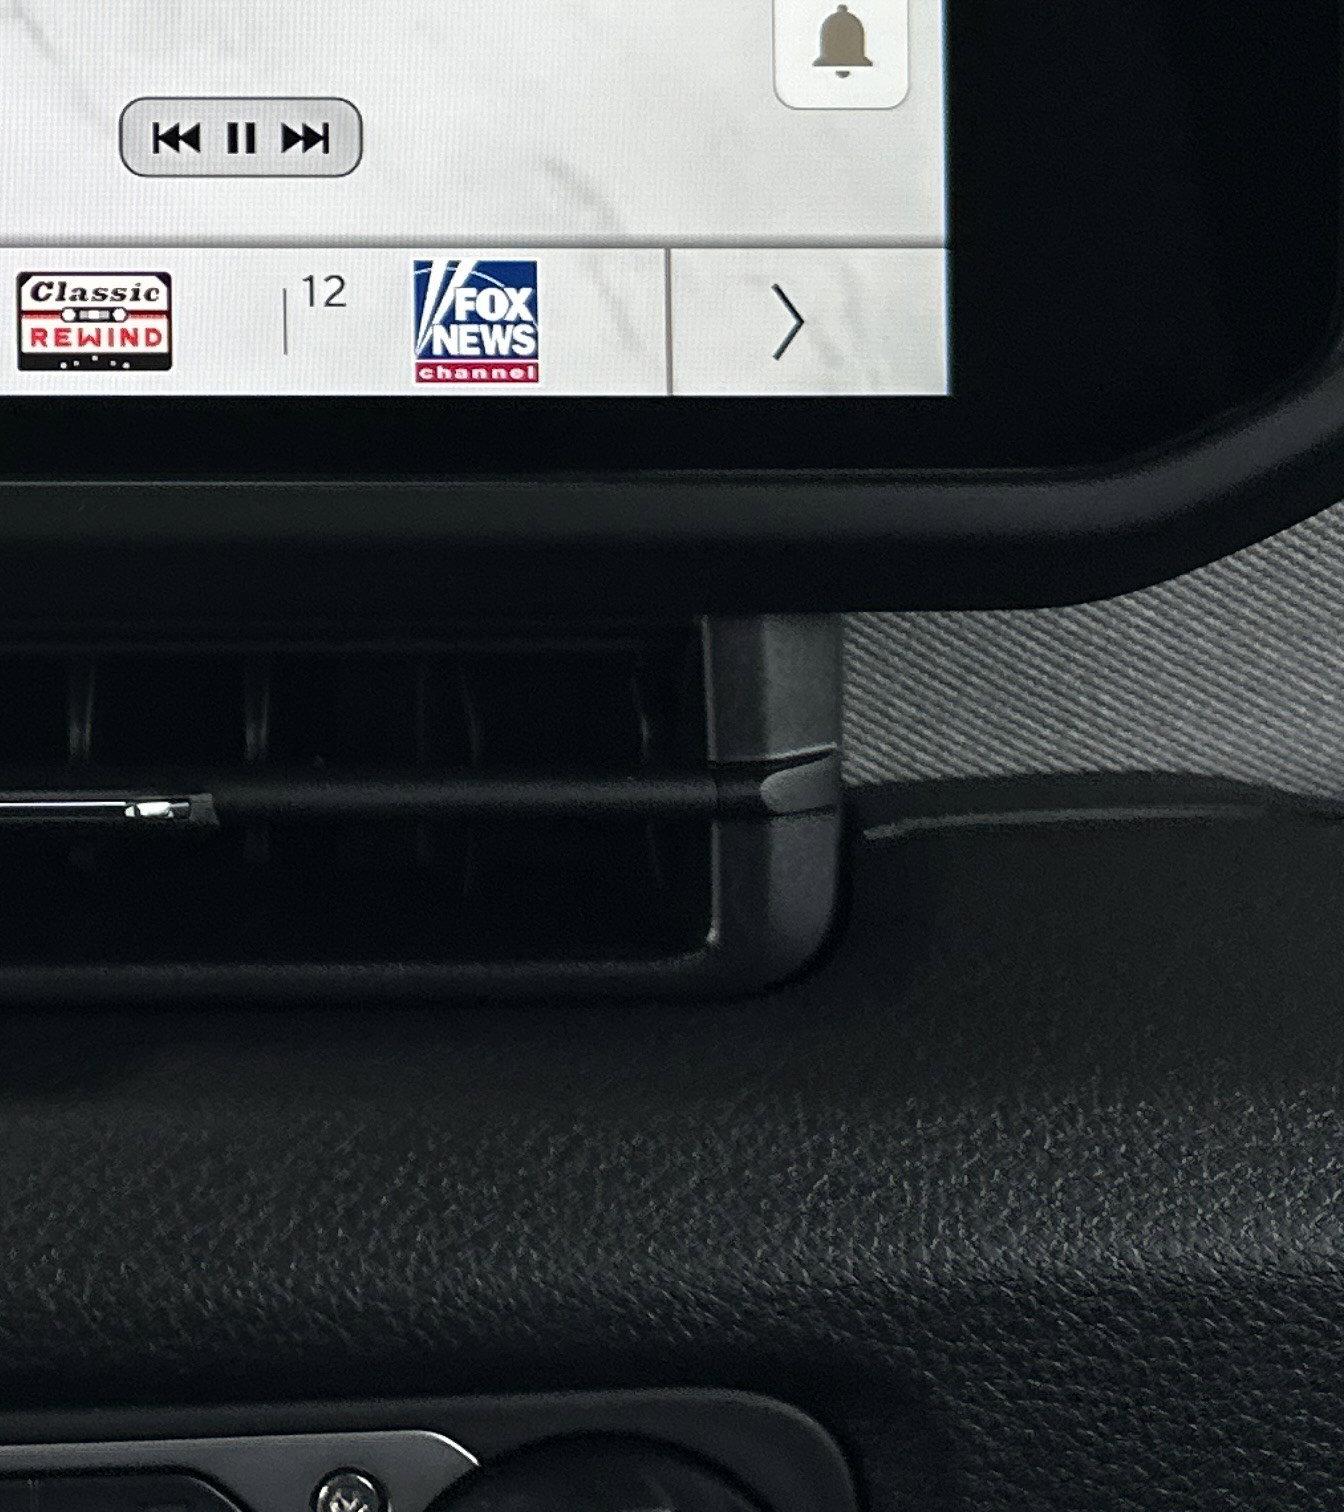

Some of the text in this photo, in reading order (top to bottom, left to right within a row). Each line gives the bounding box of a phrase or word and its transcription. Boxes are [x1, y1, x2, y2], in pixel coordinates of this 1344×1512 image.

[30, 281, 161, 304] Classic
[303, 275, 346, 307] 12
[455, 286, 534, 322] FOX
[30, 328, 163, 347] REWIND
[432, 324, 536, 356] NEWS
[418, 364, 536, 380] channel
